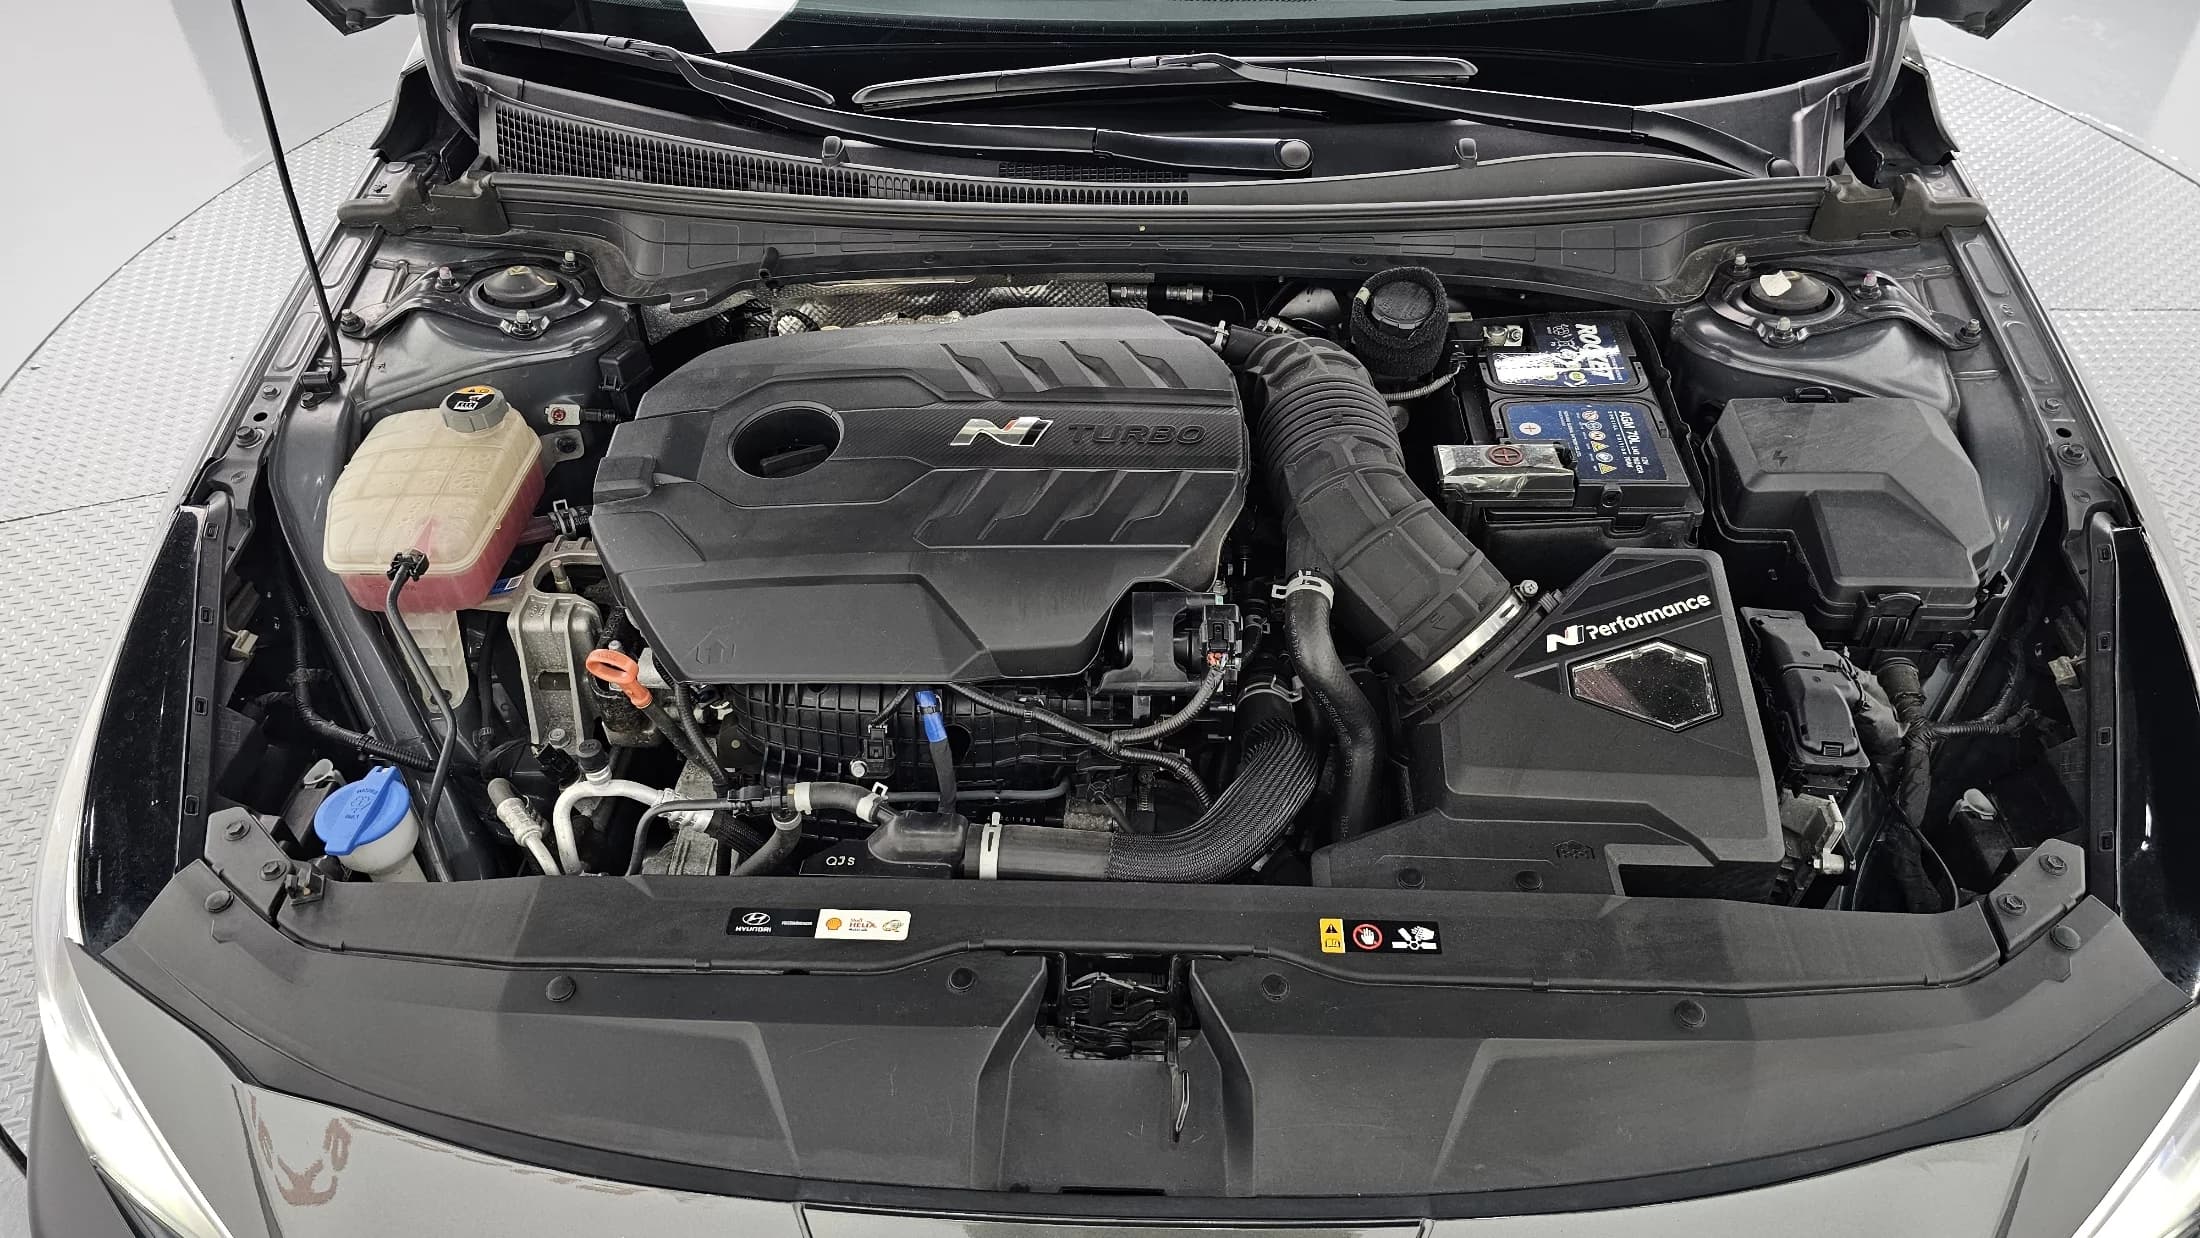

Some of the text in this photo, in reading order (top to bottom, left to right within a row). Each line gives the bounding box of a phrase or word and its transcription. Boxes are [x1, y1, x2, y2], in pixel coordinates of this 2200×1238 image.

[1618, 411, 1635, 429] AGM
[1068, 423, 1206, 444] TURBO
[1626, 430, 1640, 444] 70L
[1586, 594, 1712, 640] Performance
[826, 856, 856, 866] QJS
[849, 921, 877, 929] HELIX
